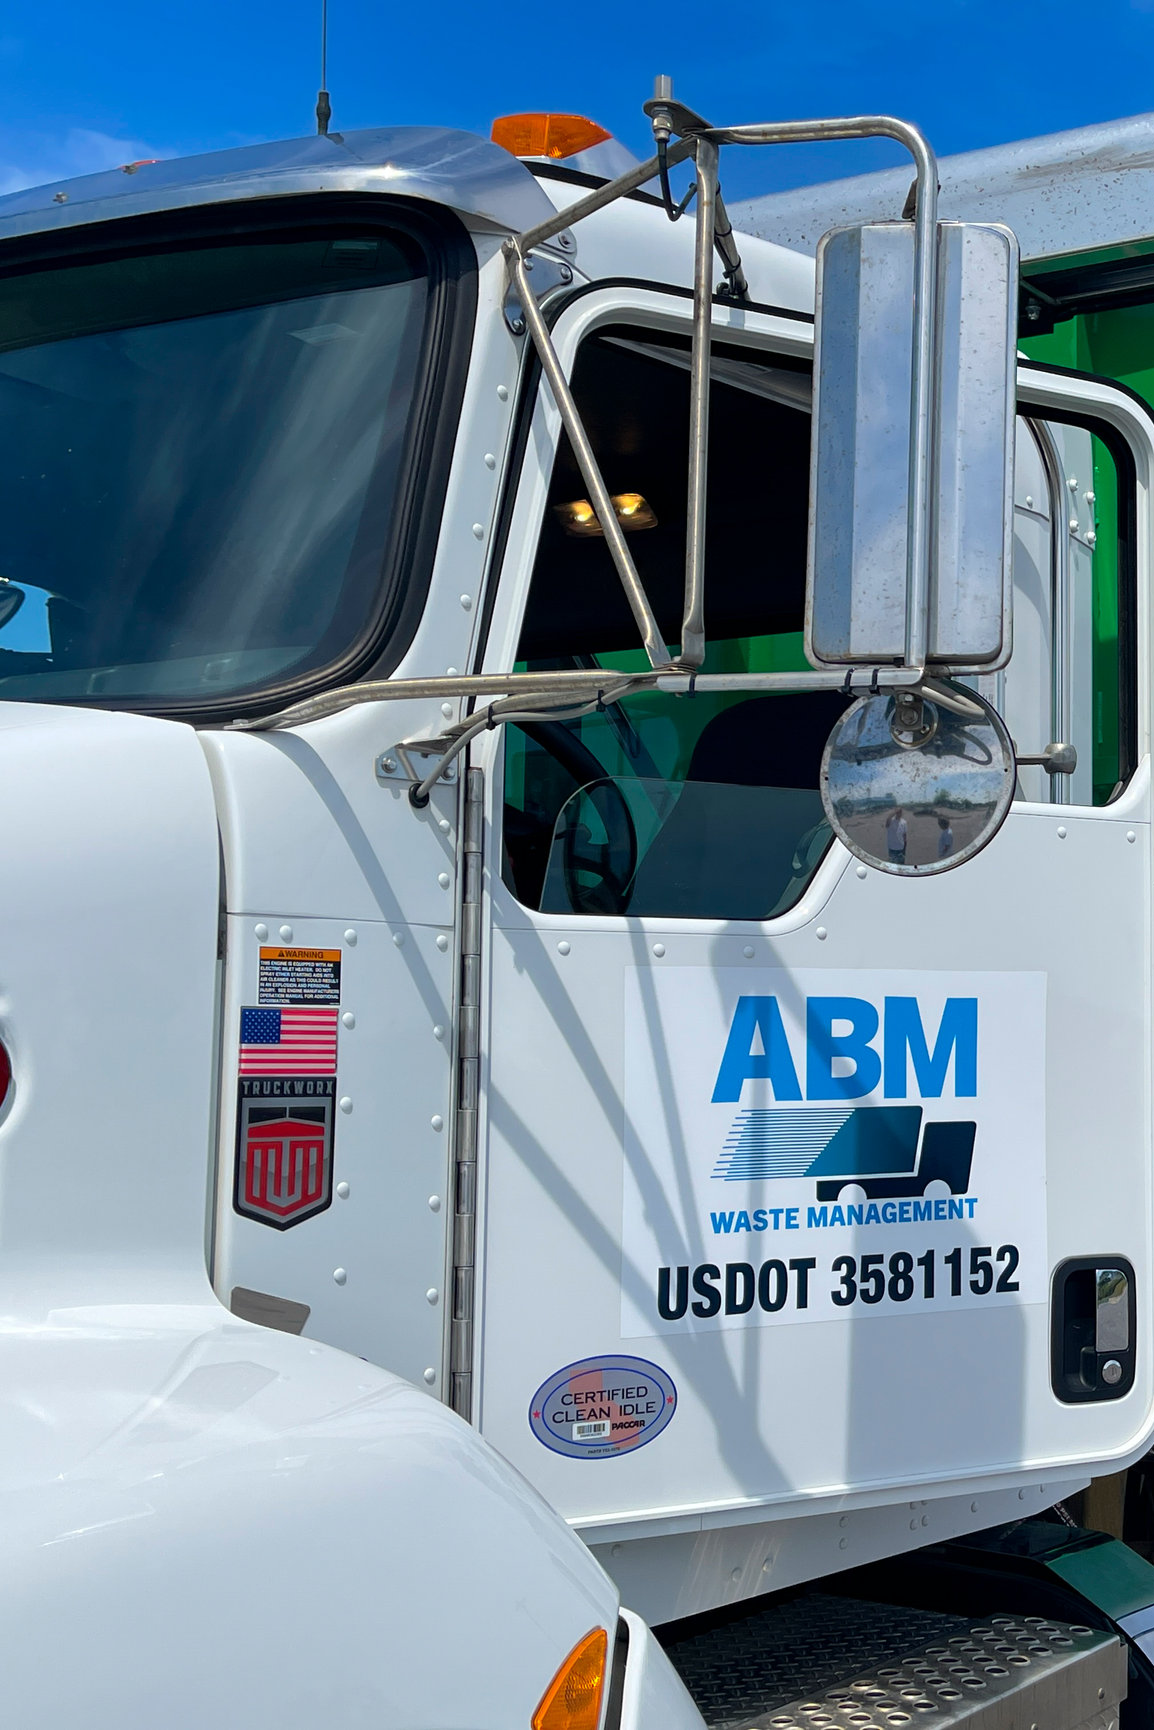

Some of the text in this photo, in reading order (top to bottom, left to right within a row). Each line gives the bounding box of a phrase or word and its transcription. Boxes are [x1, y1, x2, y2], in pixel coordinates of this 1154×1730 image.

[285, 950, 324, 959] WARNING
[710, 995, 978, 1103] ABM
[242, 1080, 333, 1096] TRUCKWORX
[710, 1198, 978, 1234] WASTE MANAGEMENT
[657, 1245, 1020, 1320] USDOT 3581152
[560, 1385, 648, 1406] CERTIFIED
[552, 1401, 657, 1424] CLEAN IDLE
[611, 1419, 646, 1431] PACCAR
